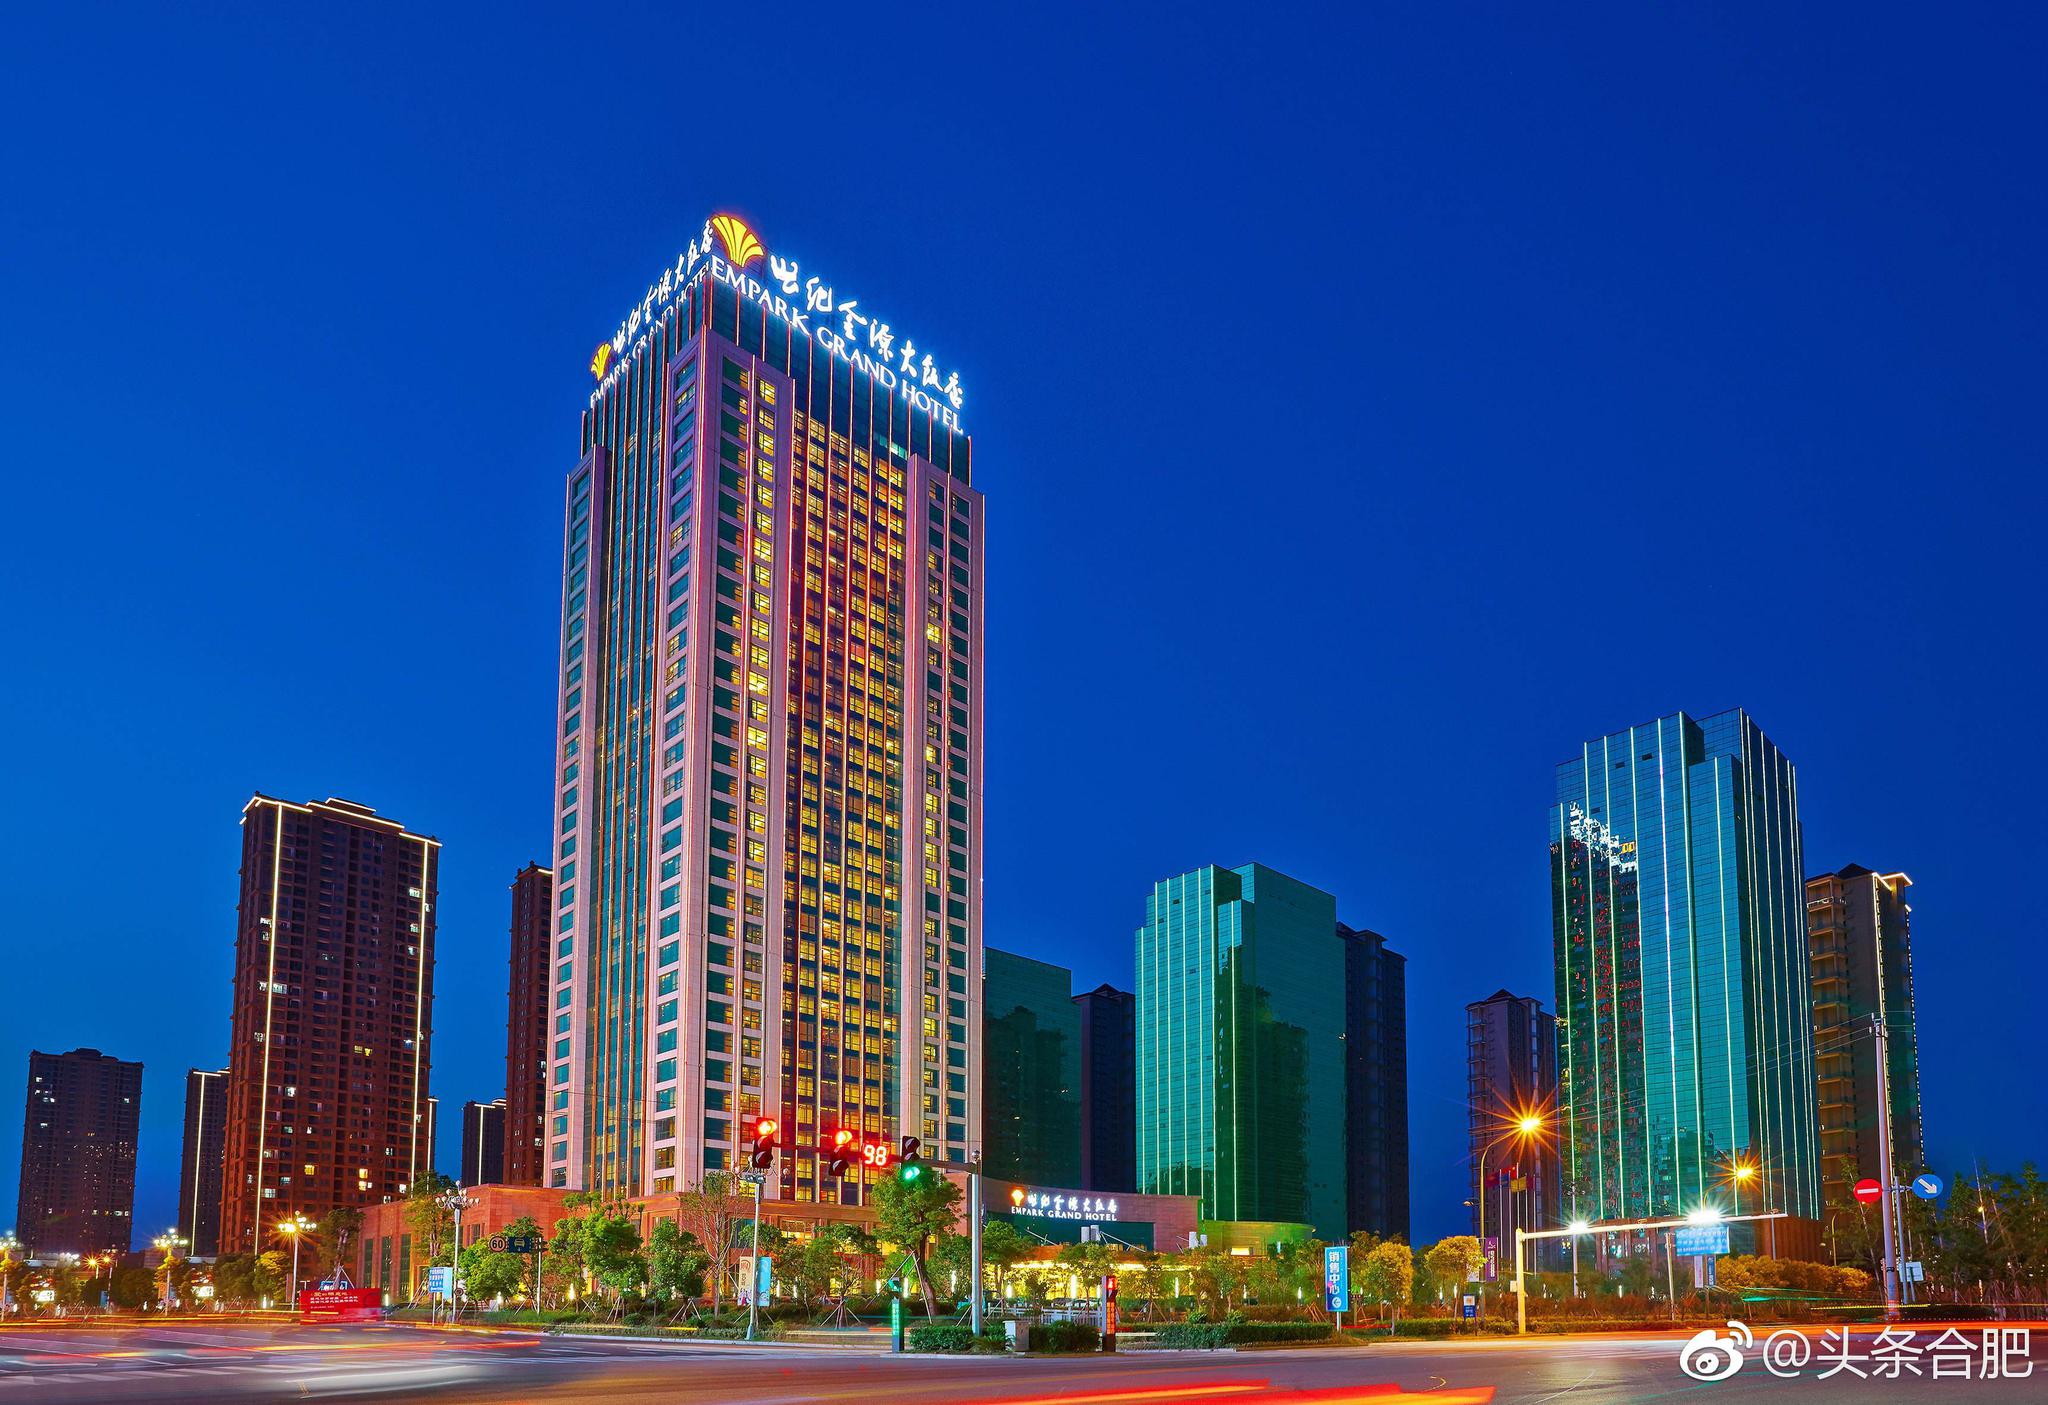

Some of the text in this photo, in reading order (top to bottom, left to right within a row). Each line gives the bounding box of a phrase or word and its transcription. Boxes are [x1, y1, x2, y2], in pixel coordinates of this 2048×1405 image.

[590, 352, 632, 408] EMPARK
[633, 305, 674, 359] GRAND
[711, 254, 964, 435] EMPARK GRAND HOTEL
[769, 254, 964, 410] 世纪金源大饭店
[863, 1144, 887, 1166] 98
[491, 1239, 503, 1249] 60
[1011, 1206, 1118, 1222] EMPARK GRAND HOTEL
